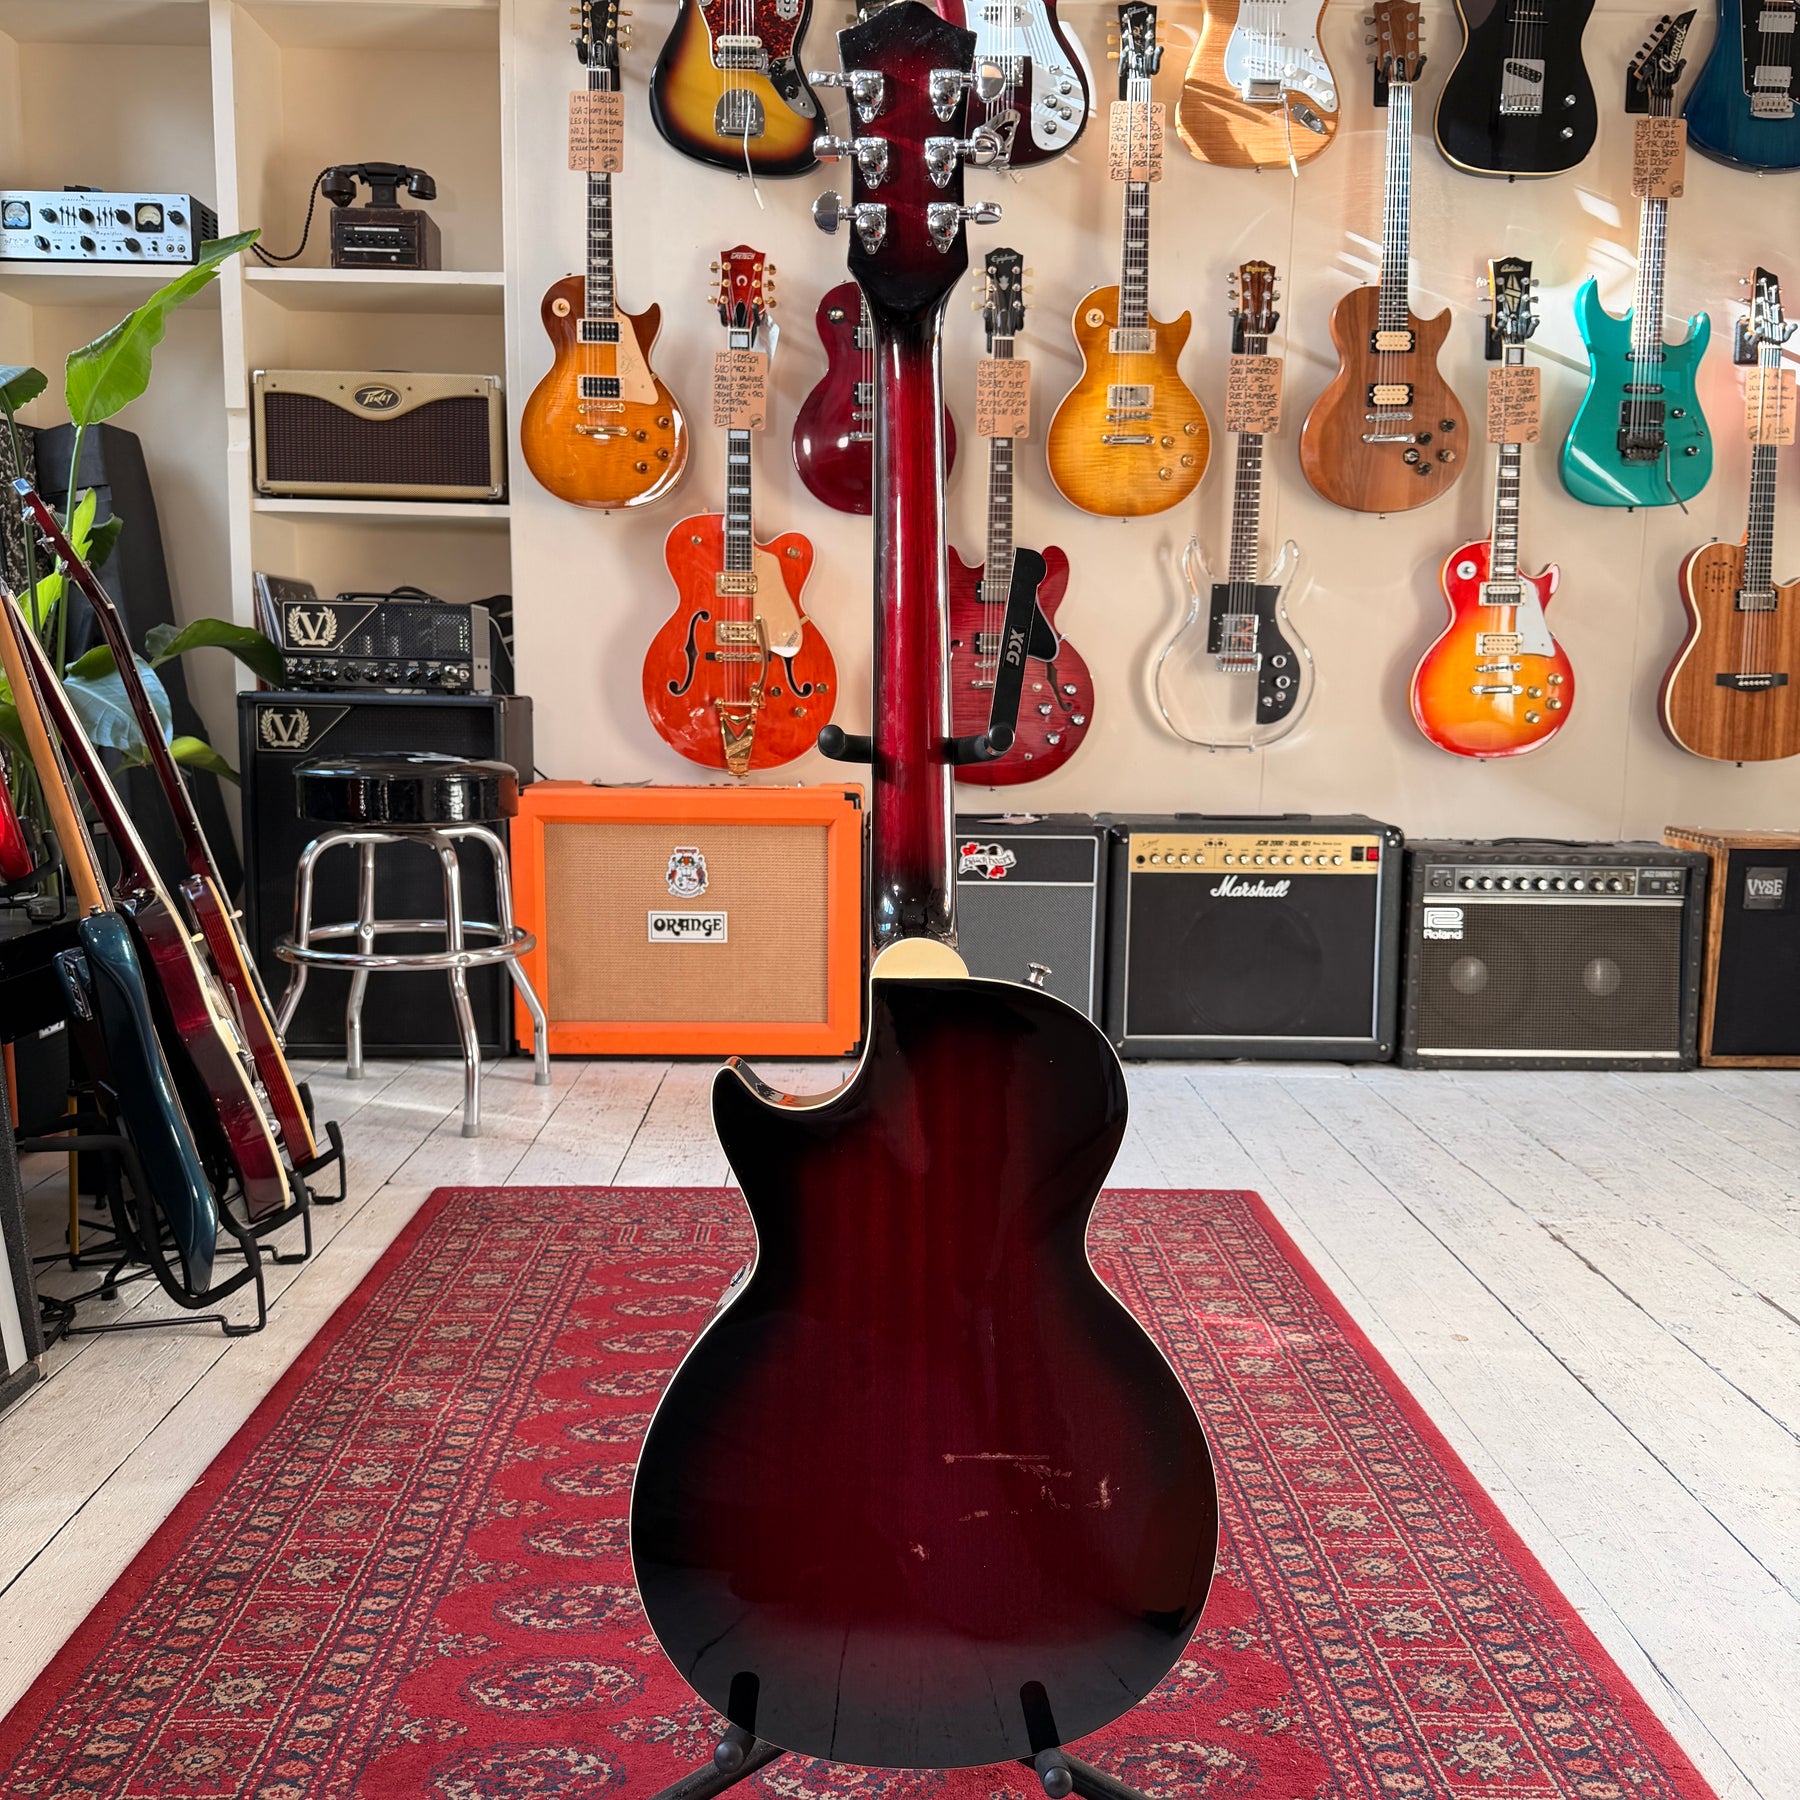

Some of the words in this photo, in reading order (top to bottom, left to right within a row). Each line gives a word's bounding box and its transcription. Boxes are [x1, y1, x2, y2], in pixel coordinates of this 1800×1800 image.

[1658, 24, 1687, 73] Charvel
[592, 95, 619, 103] GIBSON
[299, 611, 329, 641] V
[1006, 627, 1025, 666] XCG
[271, 713, 299, 743] V
[1210, 875, 1291, 898] Marshall
[1746, 878, 1784, 896] VYSE
[653, 918, 722, 937] ORANGE
[1423, 928, 1464, 940] Roland
